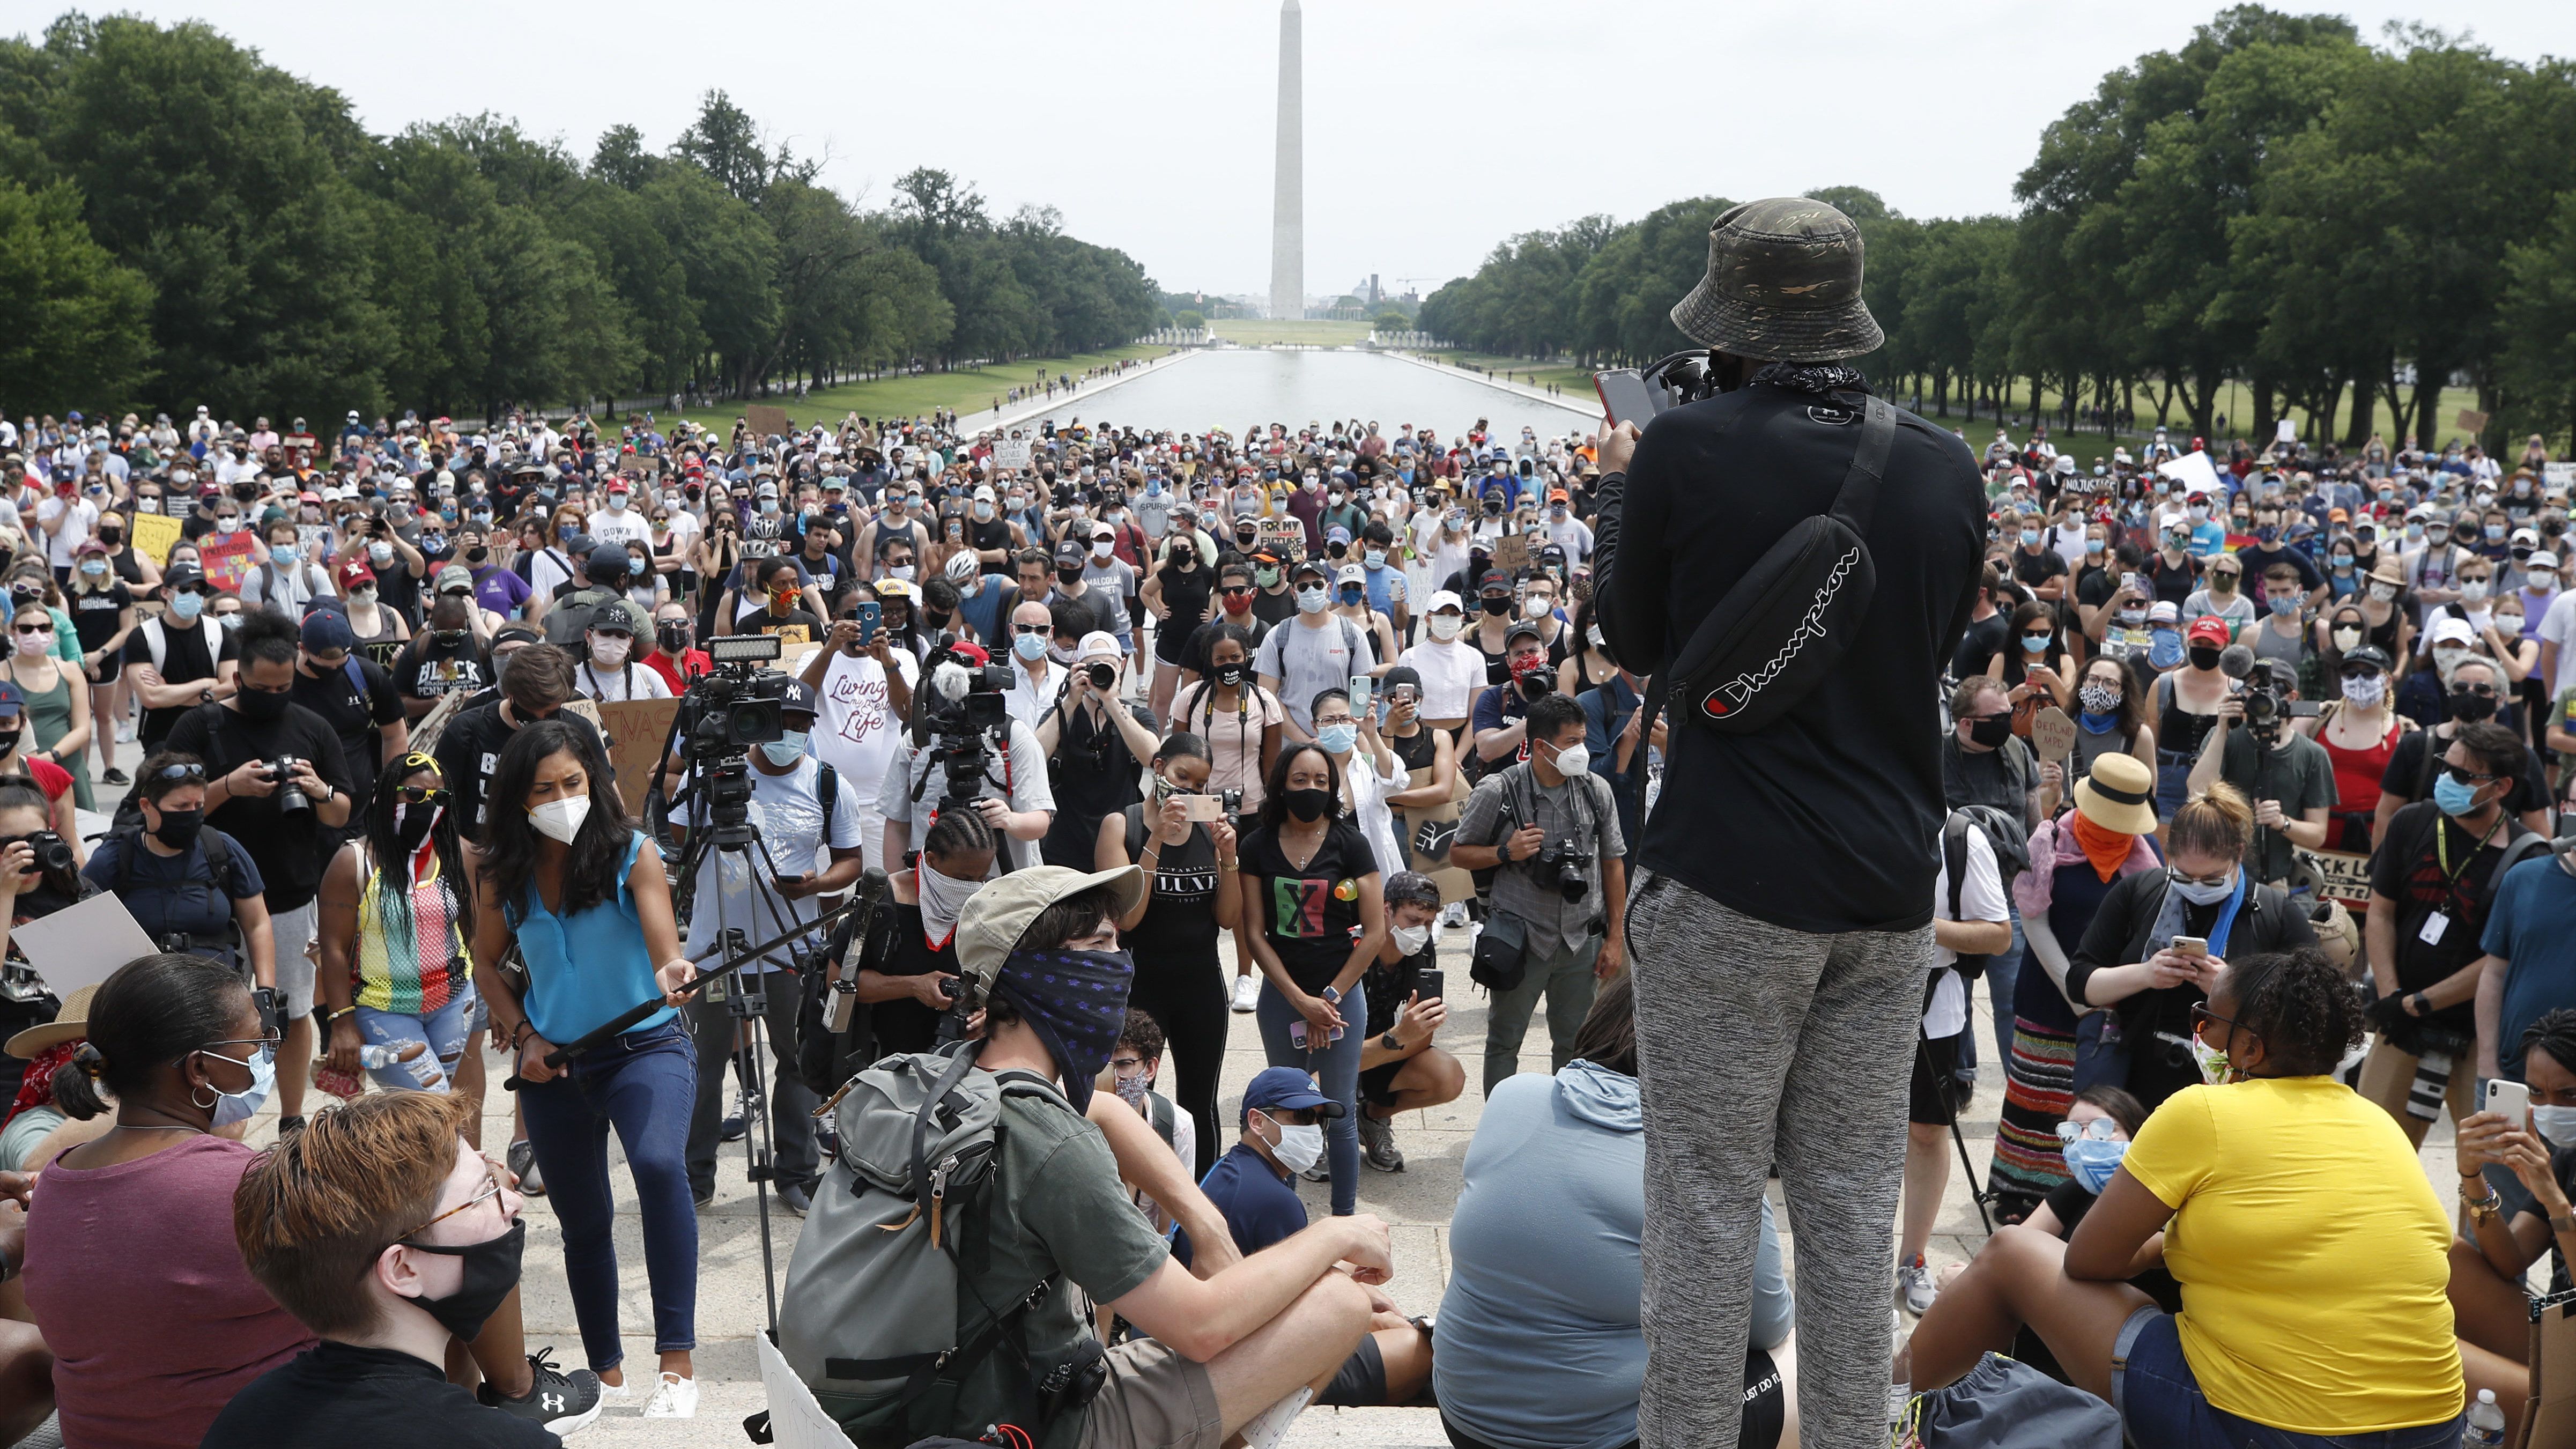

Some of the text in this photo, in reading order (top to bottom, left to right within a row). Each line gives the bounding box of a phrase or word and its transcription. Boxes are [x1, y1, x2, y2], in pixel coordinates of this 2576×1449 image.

[994, 439, 1025, 451] BLACK
[1001, 450, 1020, 459] LIVES
[2067, 479, 2077, 490] NO
[1140, 503, 1167, 511] SPURS
[603, 527, 631, 537] DOWN
[1260, 521, 1299, 531] FOR MY
[204, 541, 253, 558] PRETENDING
[1087, 577, 1121, 585] MALCOLM
[1701, 546, 1859, 718] Champion
[452, 678, 473, 686] Union
[418, 685, 446, 696] PENN
[829, 674, 888, 704] Living
[838, 709, 884, 743] Life
[2035, 720, 2073, 736] DEFUND
[2043, 737, 2064, 749] MPD
[1160, 875, 1218, 892] LUXE
[1283, 882, 1321, 933] X
[1759, 1379, 1773, 1392] DO
[1773, 1374, 1782, 1386] IT.
